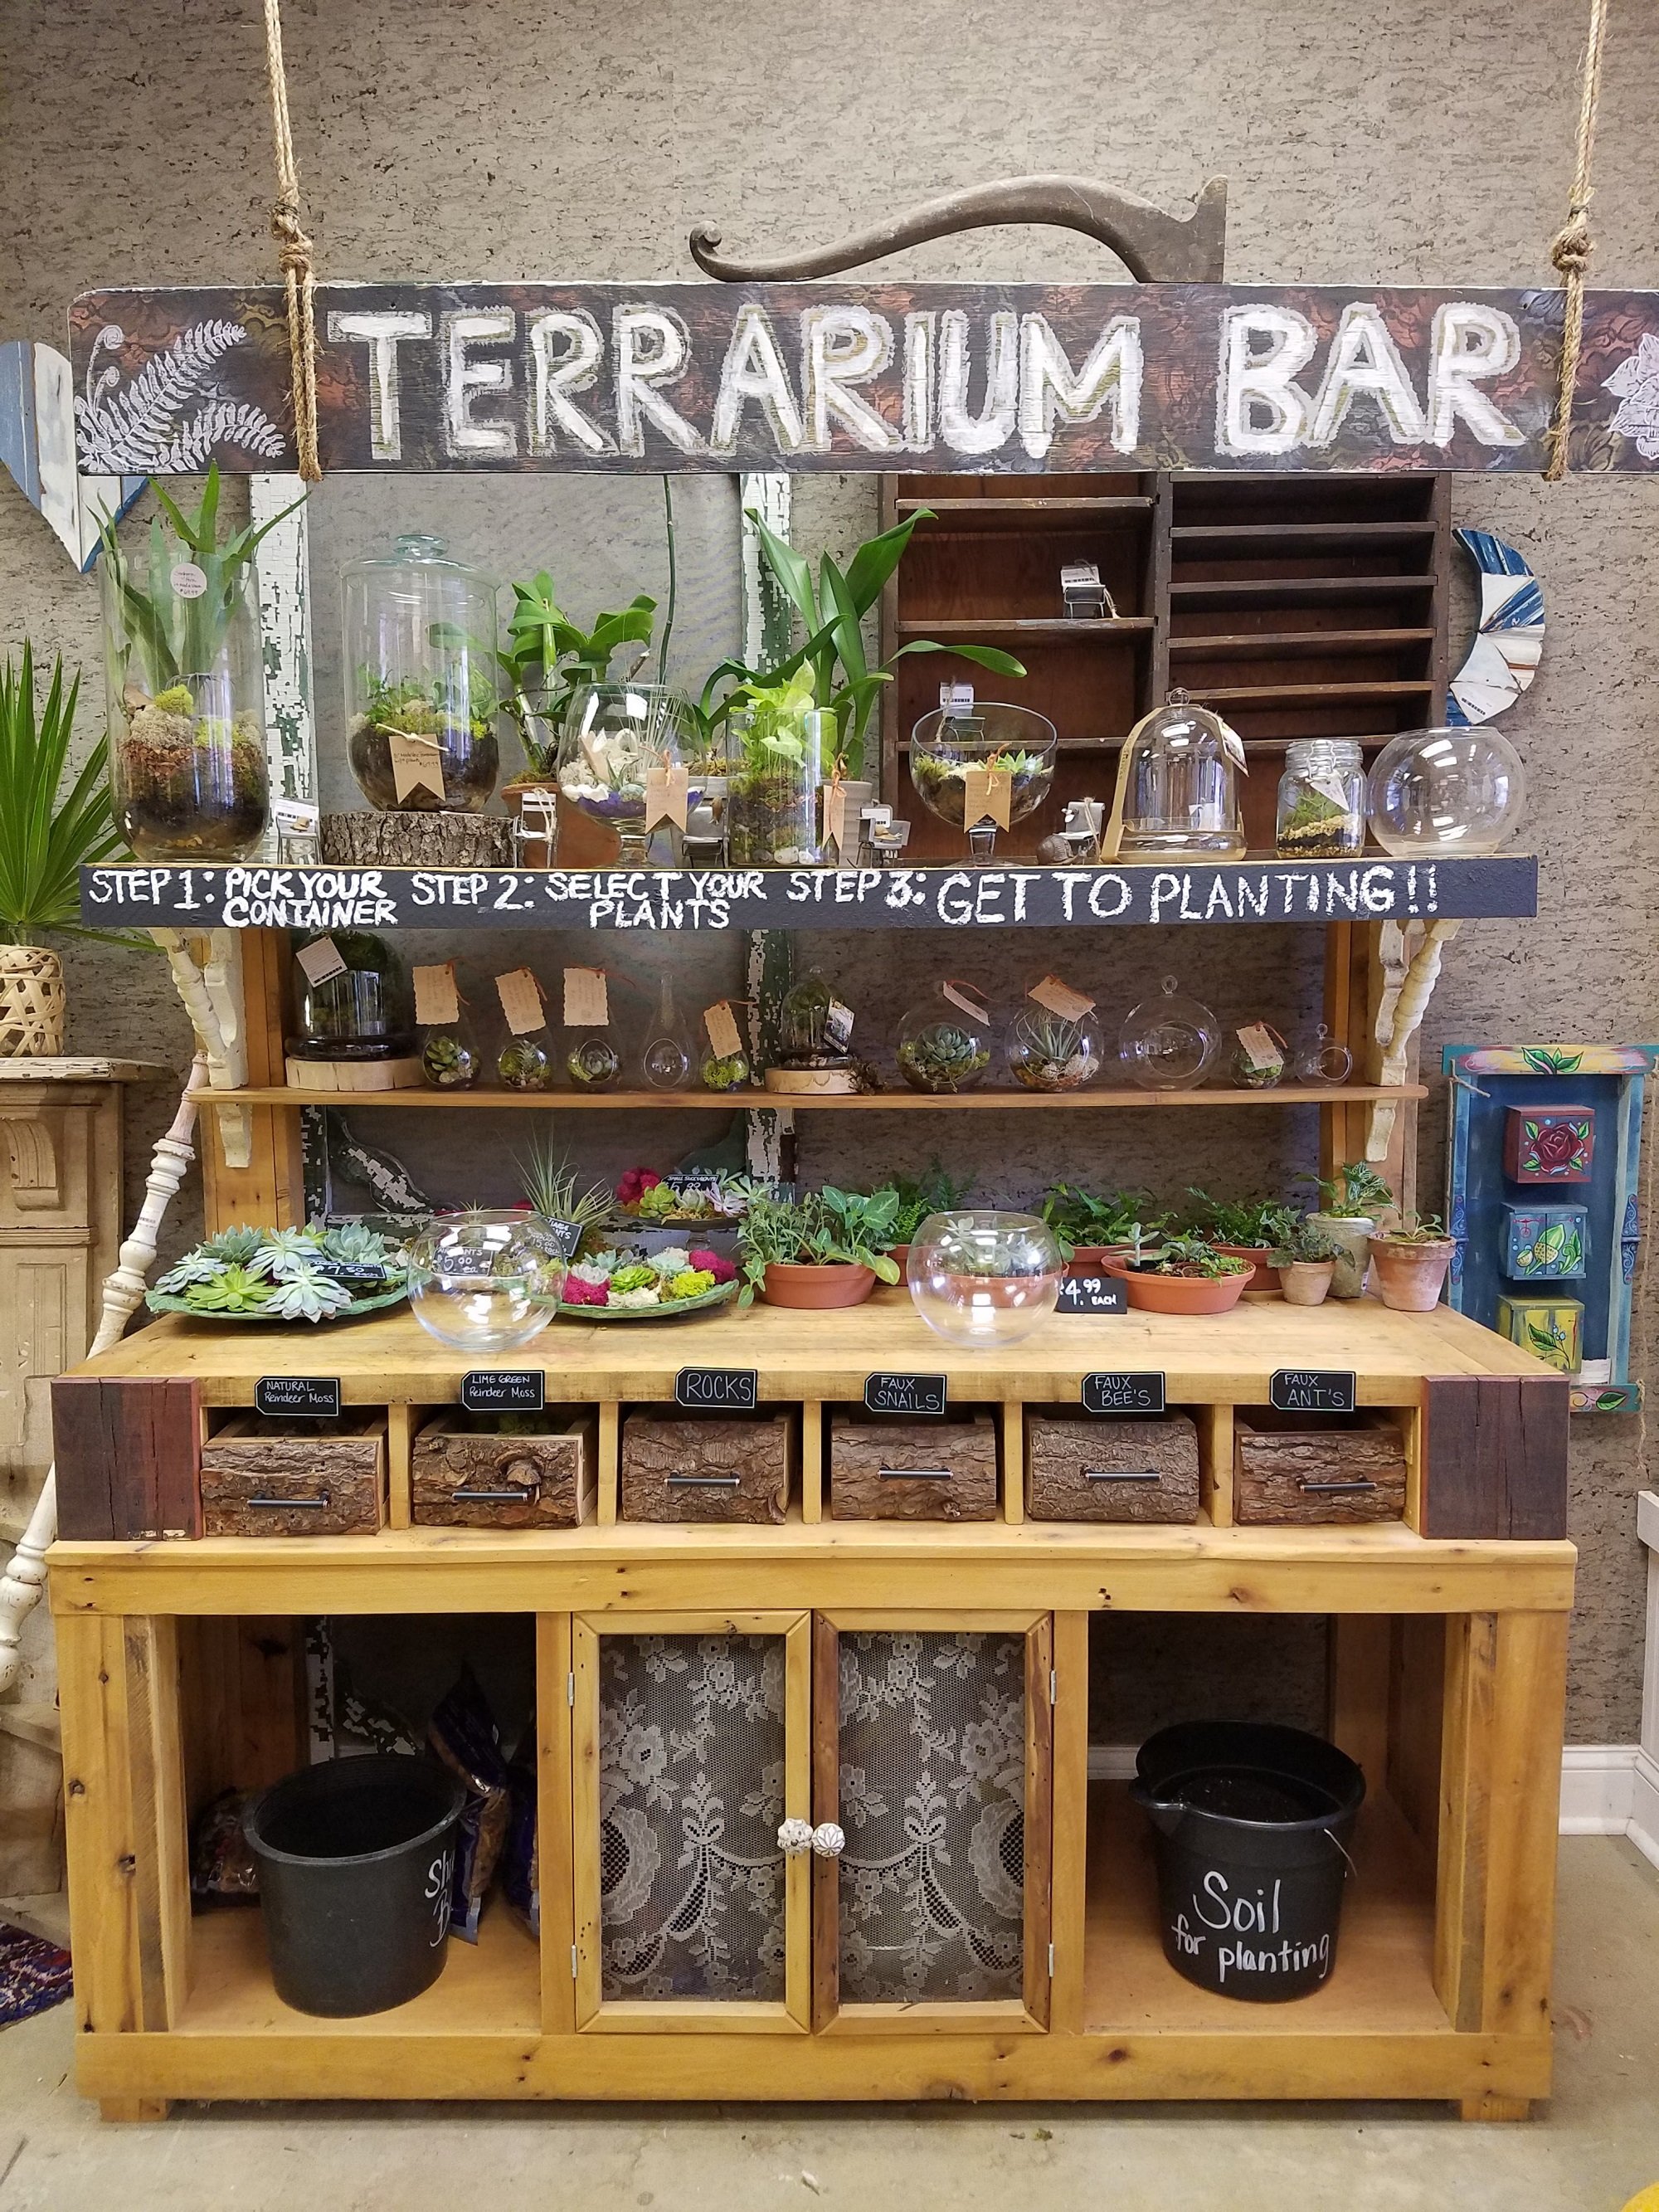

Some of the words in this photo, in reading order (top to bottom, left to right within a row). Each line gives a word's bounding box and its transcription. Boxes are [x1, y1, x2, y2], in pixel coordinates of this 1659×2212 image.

[327, 303, 1144, 460] TERRARIUM
[1215, 302, 1526, 456] BAR
[89, 868, 173, 905] STEP
[173, 870, 216, 910] 1:
[225, 867, 295, 899] PICK
[296, 870, 389, 900] YOUR
[411, 872, 489, 906] STEP
[493, 875, 536, 910] 2:
[544, 871, 684, 901] SELECT
[687, 871, 769, 900] YOUR
[786, 870, 882, 904] STEP
[884, 871, 928, 909] 3:
[936, 871, 1042, 927] GET
[1052, 871, 1134, 922] TO
[1148, 864, 1439, 924] PLANTING!!
[221, 895, 399, 928] CONTAINER
[588, 899, 731, 930] PLANTS
[266, 1381, 315, 1392] NATURAL
[469, 1385, 507, 1397] Reindeer
[511, 1386, 535, 1398] Moss
[472, 1374, 496, 1384] LIME
[498, 1374, 530, 1384] GREEN
[686, 1372, 752, 1401] ROCKS
[881, 1377, 915, 1391] FAUX
[1095, 1376, 1131, 1390] FAUX
[1283, 1373, 1318, 1387] FAUX
[264, 1391, 305, 1403] Reindeer
[309, 1392, 334, 1403] Moss
[874, 1391, 940, 1411] SNAILS
[1102, 1389, 1151, 1406] BEE'S
[1287, 1388, 1345, 1407] ANT'S
[1192, 1870, 1281, 1934] Soil
[1170, 1912, 1207, 1956] for
[1218, 1933, 1330, 1983] planting
